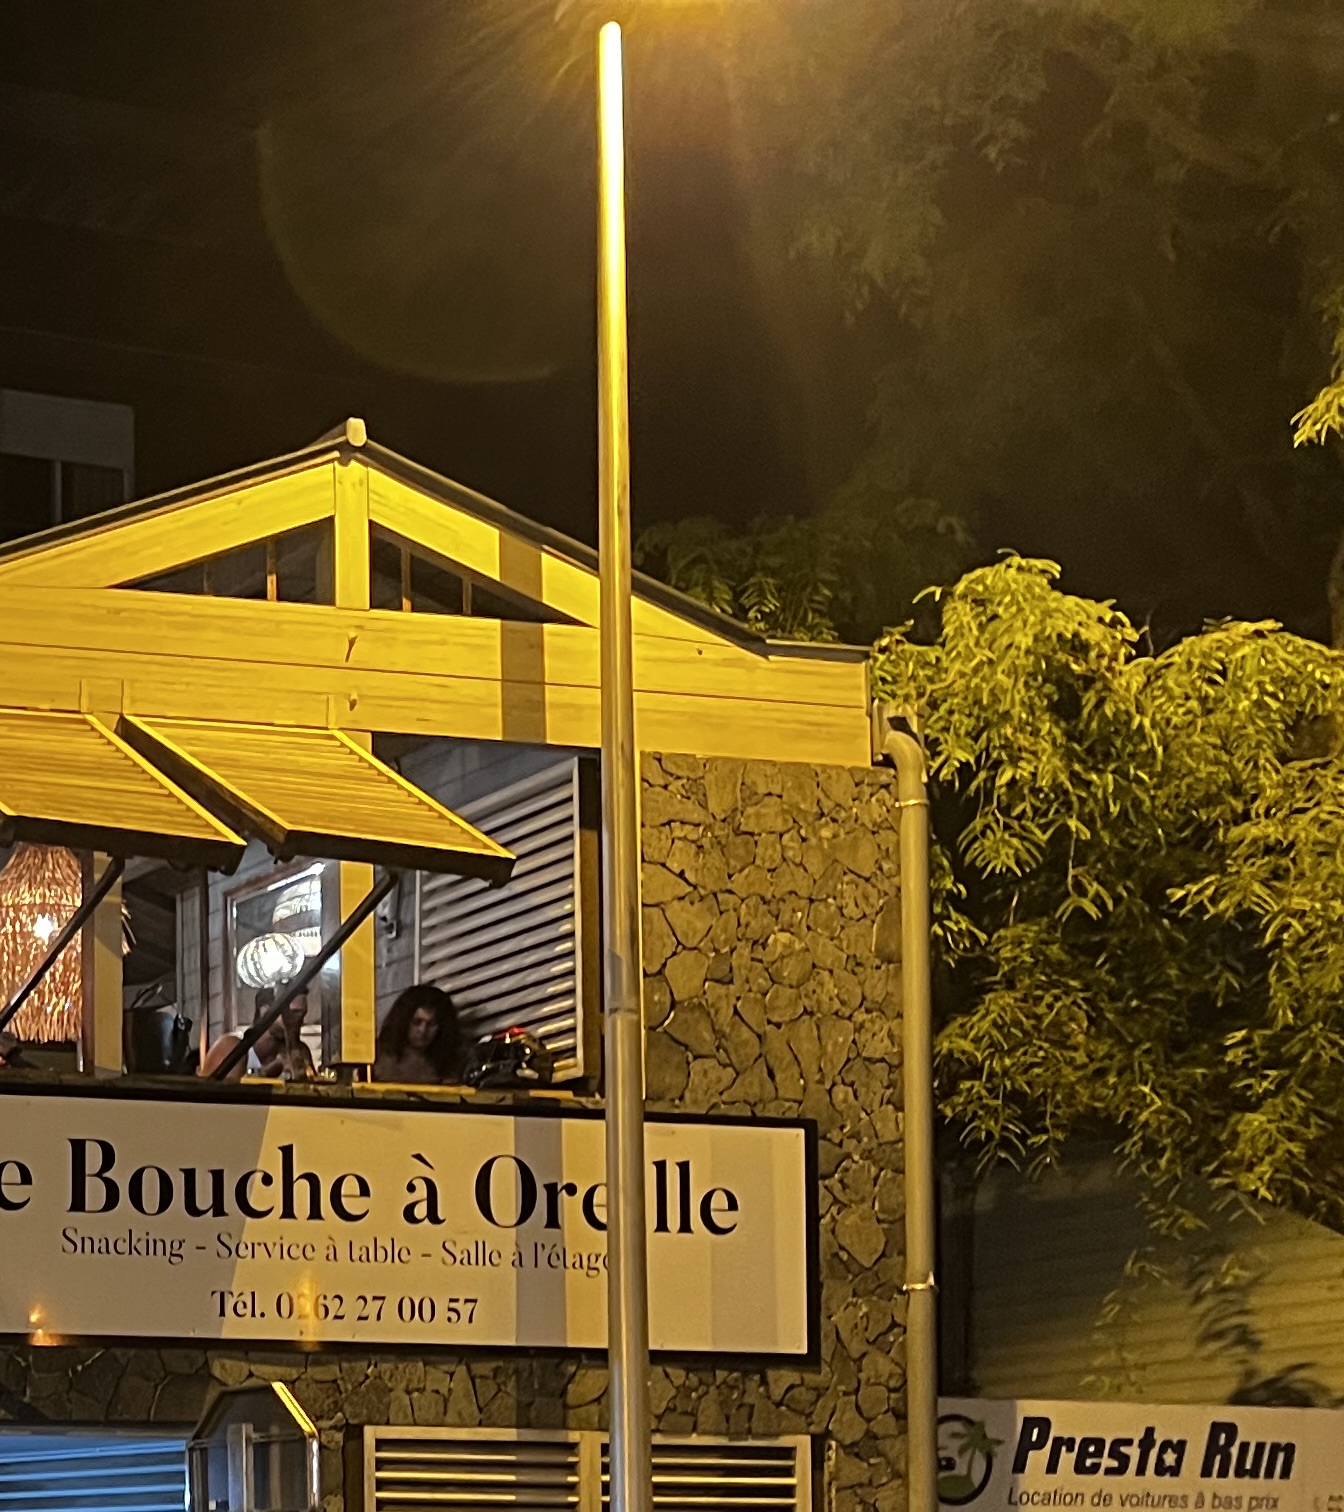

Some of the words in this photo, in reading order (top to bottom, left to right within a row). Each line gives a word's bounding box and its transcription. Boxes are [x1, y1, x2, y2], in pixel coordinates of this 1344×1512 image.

[65, 1137, 371, 1223] Bouche
[401, 1152, 447, 1227] à
[474, 1153, 740, 1236] Orelle
[61, 1226, 186, 1266] Snacking
[215, 1231, 316, 1262] Service
[324, 1236, 339, 1263] à
[348, 1236, 412, 1265] table
[440, 1238, 502, 1268] Salle
[511, 1240, 524, 1269] à
[210, 1289, 266, 1319] Tél.
[355, 1294, 387, 1322] 27
[397, 1295, 436, 1324] 00
[446, 1297, 479, 1324] 57
[1012, 1415, 1188, 1477] Presta
[1200, 1420, 1296, 1480] Run
[1007, 1486, 1085, 1508] Location
[1091, 1488, 1113, 1508] de
[1119, 1489, 1189, 1510] voitures
[1212, 1490, 1243, 1511] bas
